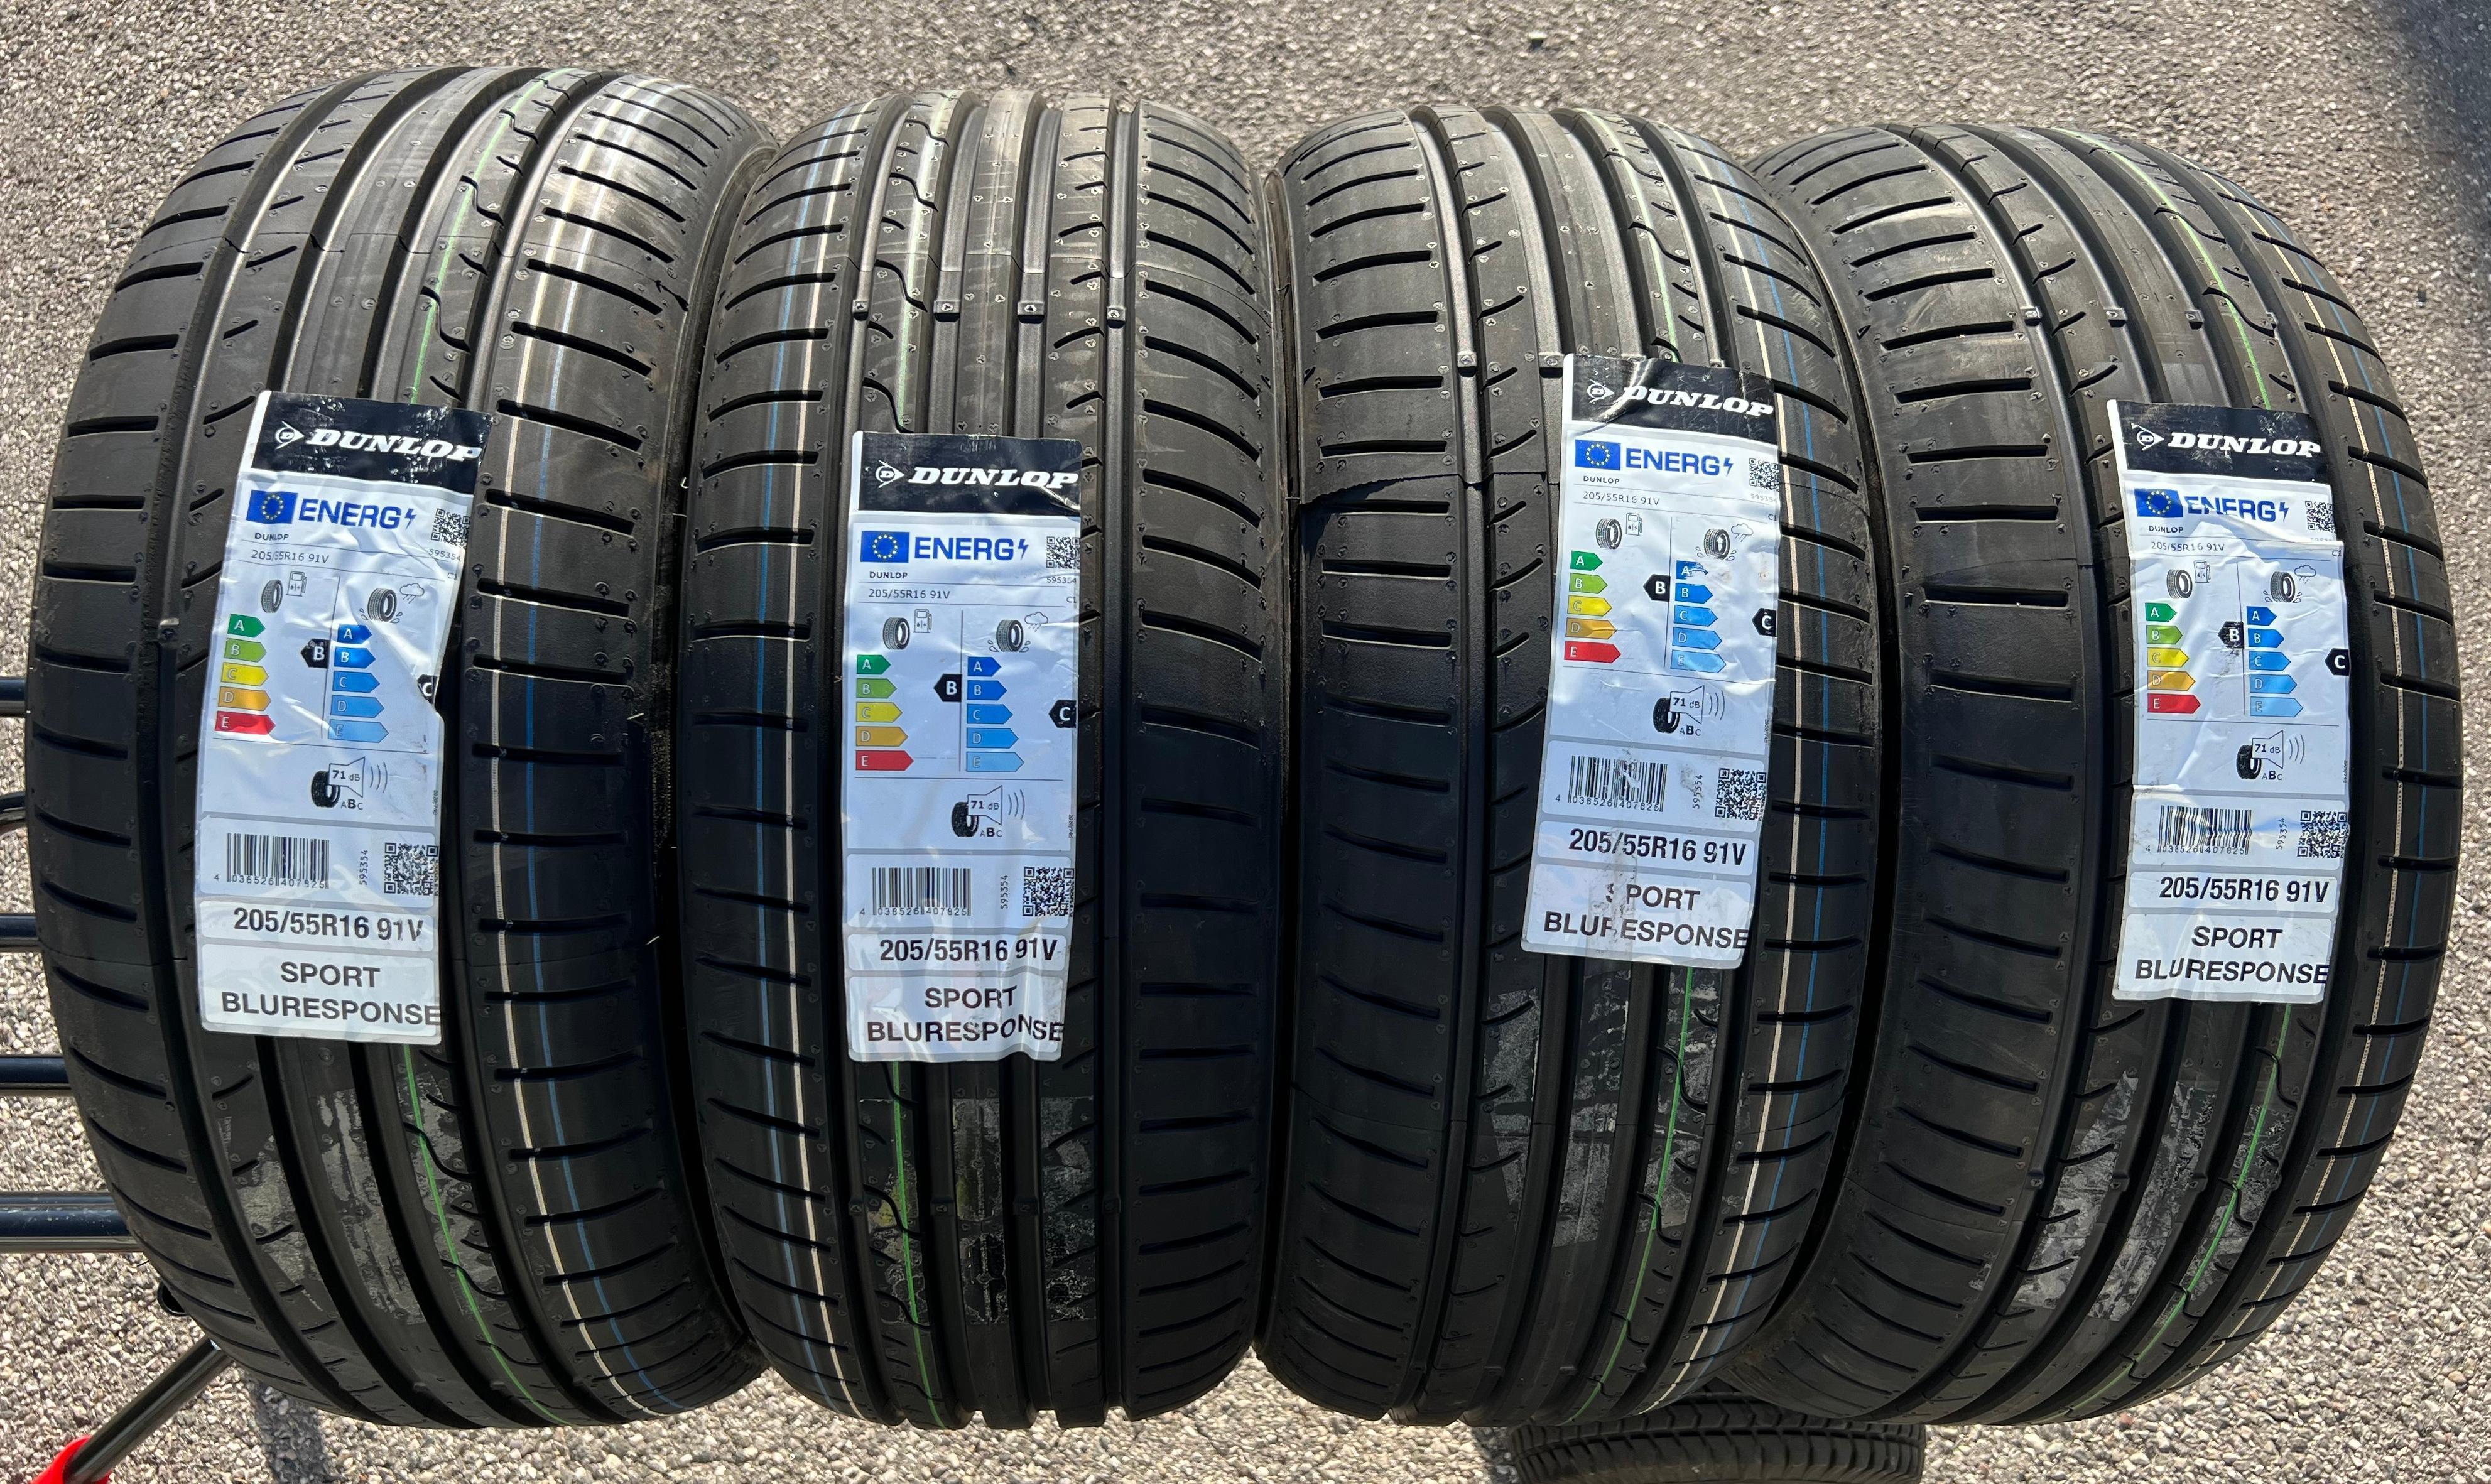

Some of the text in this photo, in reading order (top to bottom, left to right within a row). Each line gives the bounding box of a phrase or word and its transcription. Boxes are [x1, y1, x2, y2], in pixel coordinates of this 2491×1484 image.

[1622, 385, 1773, 418] DUNLOP
[307, 428, 482, 462] DUNLOP
[2168, 432, 2321, 457] DUNLOP
[1626, 448, 1720, 475] ENERG
[908, 467, 1078, 489] DUNLOP
[1583, 476, 1619, 484] DUNLOP
[1583, 492, 1660, 506] 205/55R16 91V
[298, 497, 400, 529] ENERG
[2184, 495, 2276, 522] ENERG
[2149, 525, 2184, 533] DUNLOP
[255, 533, 289, 541] DUNLOP
[914, 536, 1014, 561] ENERG
[2151, 541, 2225, 552] 205/55R16 91V
[251, 550, 330, 563] 205/55R16 91V
[428, 548, 462, 562] 595354
[1576, 556, 1584, 566] A
[448, 571, 459, 580] C1
[1681, 565, 1689, 576] A
[1575, 579, 1582, 588] B
[1655, 581, 1666, 593] B
[868, 589, 950, 599] 205/55R16 91V
[1681, 588, 1689, 598] B
[1573, 601, 1582, 611] C
[1680, 610, 1688, 620] C
[2151, 607, 2159, 617] A
[2252, 611, 2260, 621] A
[234, 620, 244, 631] A
[1761, 615, 1772, 629] C
[1571, 623, 1580, 633] D
[343, 629, 352, 639] A
[1678, 633, 1686, 643] D
[2152, 630, 2159, 640] B
[2230, 629, 2240, 642] B
[2254, 634, 2260, 643] B
[231, 644, 240, 655] B
[313, 647, 325, 660] B
[1570, 647, 1577, 658] E
[341, 652, 349, 663] B
[1678, 656, 1684, 666] E
[2152, 653, 2160, 663] C
[2254, 657, 2262, 666] C
[2334, 655, 2345, 668] C
[862, 660, 872, 669] A
[974, 662, 982, 671] A
[228, 669, 236, 680] C
[2152, 675, 2161, 685] D
[339, 677, 347, 688] C
[946, 681, 957, 695] B
[2255, 680, 2263, 689] D
[862, 685, 870, 694] B
[974, 686, 982, 695] B
[224, 692, 233, 703] D
[1673, 698, 1700, 708] 71 dB
[338, 700, 346, 712] D
[2153, 699, 2159, 708] E
[2256, 702, 2262, 712] E
[862, 708, 871, 718] C
[973, 710, 980, 720] C
[1059, 707, 1071, 722] C
[221, 717, 229, 728] E
[336, 725, 344, 736] E
[861, 731, 870, 741] D
[973, 734, 982, 743] D
[2255, 744, 2266, 752] 71
[861, 756, 868, 766] E
[974, 757, 980, 767] E
[332, 771, 361, 782] 71 dB
[1693, 774, 1702, 809] 595354
[970, 800, 999, 810] 71 dB
[1556, 794, 1560, 803] 4
[1573, 795, 1612, 806] 038526
[2276, 818, 2287, 850] 595354
[1568, 828, 1746, 865] 205/55R16 91V
[2162, 844, 2198, 853] 038526
[2205, 845, 2244, 855] 407825
[359, 850, 368, 885] 595354
[232, 874, 274, 886] 038526
[2159, 877, 2329, 903] 205/55R16 91V
[926, 907, 967, 916] 407825
[234, 907, 423, 941] 205/55R16 91V
[2191, 926, 2282, 949] SPORT
[880, 937, 1058, 962] 205/55R16 91V
[281, 961, 381, 988] SPORT
[2135, 959, 2329, 984] BLURESPONSE
[925, 985, 1018, 1009] SPORT
[222, 991, 440, 1026] BLURESPONSE
[868, 1014, 1065, 1043] BLURESPONSE
